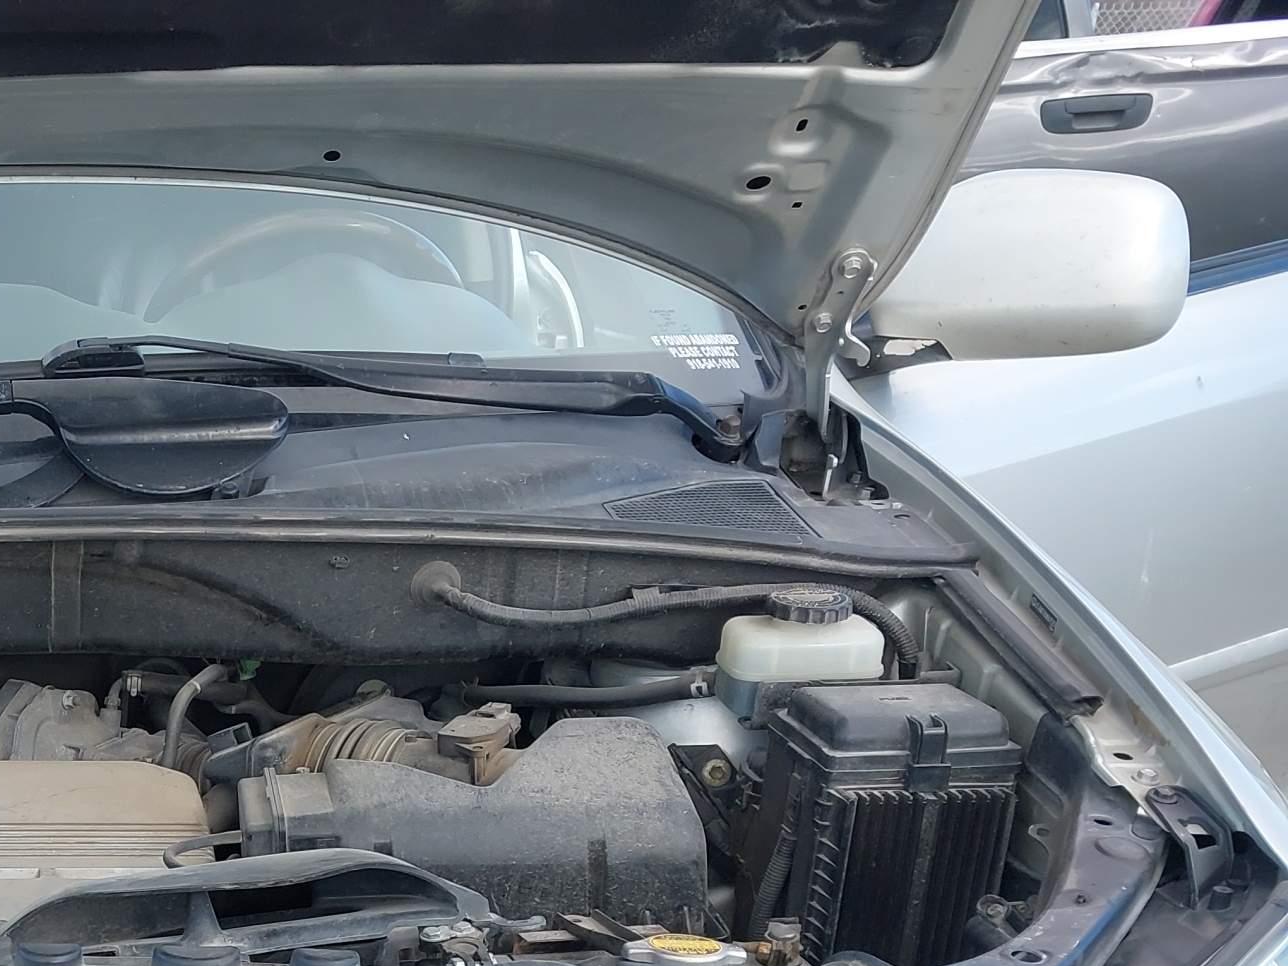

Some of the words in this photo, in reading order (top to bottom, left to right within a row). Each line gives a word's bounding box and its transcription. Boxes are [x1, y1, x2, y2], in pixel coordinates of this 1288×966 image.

[650, 335, 662, 346] IF
[659, 335, 693, 346] FOUND
[689, 334, 740, 345] ABANDONED
[668, 346, 701, 358] PLEASE
[699, 346, 740, 357] CONTACT
